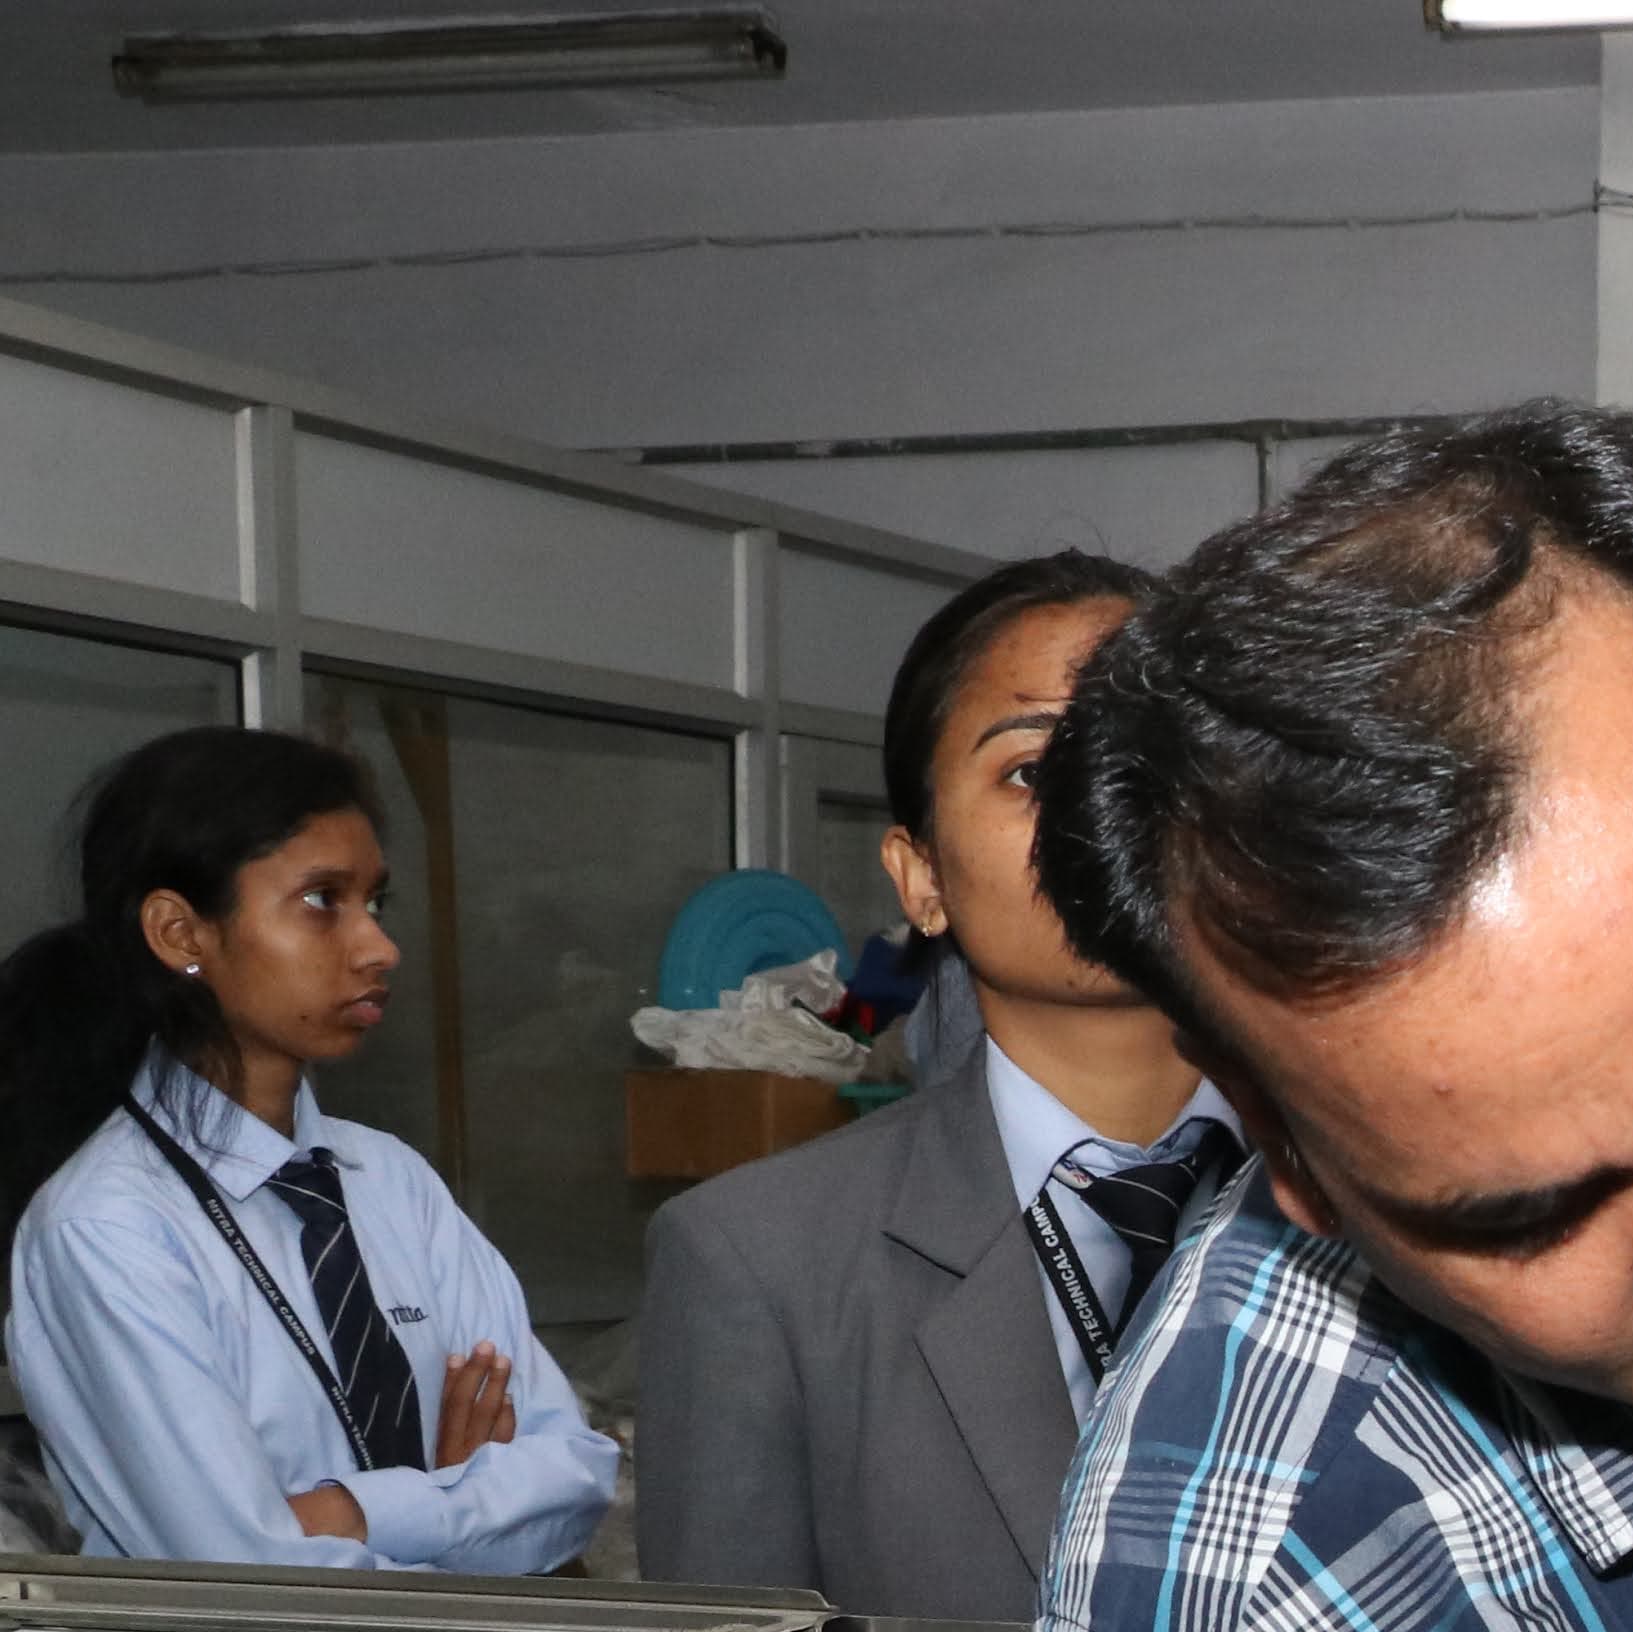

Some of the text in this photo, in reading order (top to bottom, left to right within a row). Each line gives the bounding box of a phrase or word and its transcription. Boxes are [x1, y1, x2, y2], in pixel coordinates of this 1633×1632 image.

[206, 1199, 316, 1355] NITRA TECHNICAL CAMPUS
[1052, 1248, 1102, 1342] TECHNICAL
